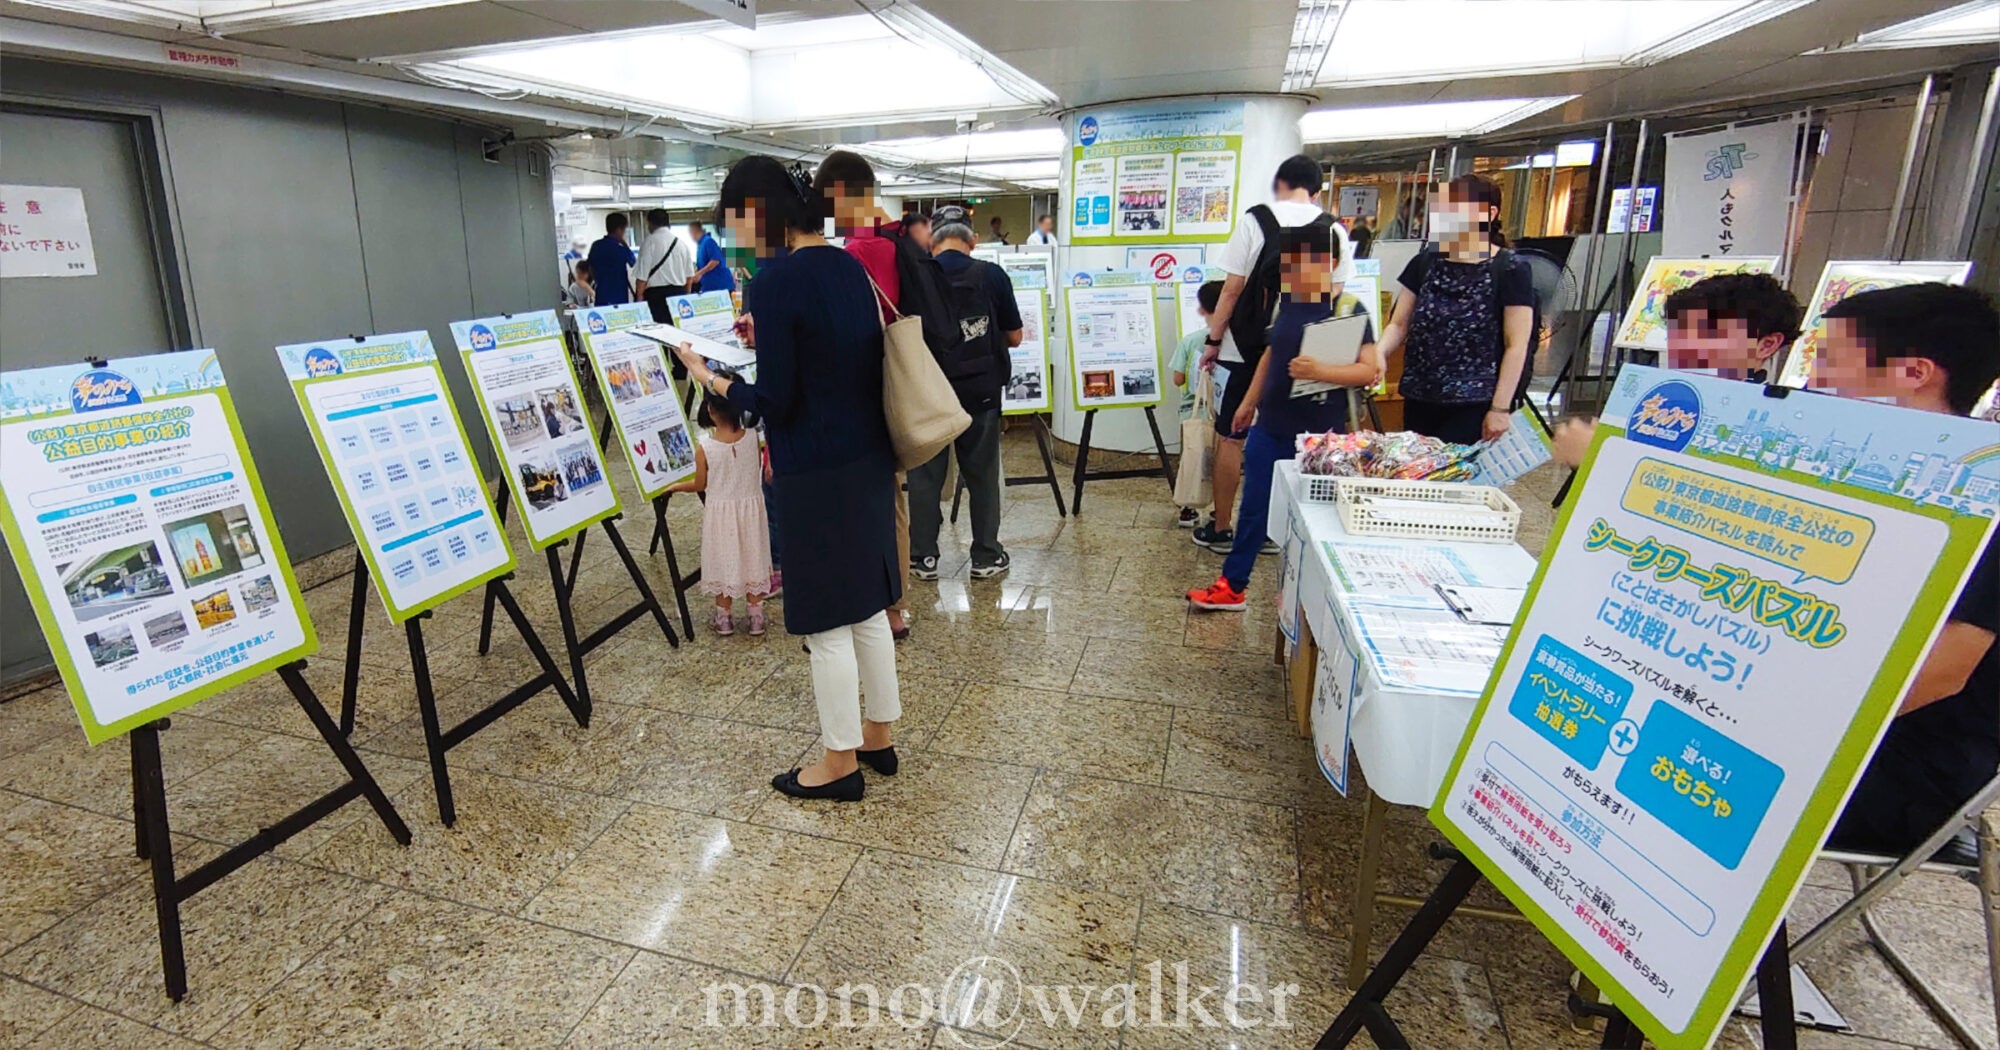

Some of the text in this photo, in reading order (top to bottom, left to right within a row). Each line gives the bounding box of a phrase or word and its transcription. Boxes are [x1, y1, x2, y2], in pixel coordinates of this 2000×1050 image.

[43, 421, 191, 462] 公益目的事業の紹介
[1639, 469, 1855, 548] (公財)東京都道路整備保全公社の
[1653, 499, 1806, 562] 事業紹介パネルを読んで
[1583, 517, 1847, 649] シークワーズパズル
[1611, 571, 1771, 656] (ことばさがしパズル)
[125, 630, 275, 696] 得られた収益を、公益目的事業を通して
[167, 652, 250, 691] 広く都民・社会に還元
[1596, 597, 1753, 691] に挑戦しよう!
[1530, 672, 1607, 726] イベントラリー
[1535, 649, 1622, 709] 豪華賞品が当たる!
[1533, 701, 1580, 740] 抽選券
[1562, 765, 1636, 826] がもらえます!!
[1649, 755, 1733, 820] おもちゃ
[1680, 745, 1733, 785] 選べる!
[1560, 808, 1602, 849] 参加方法
